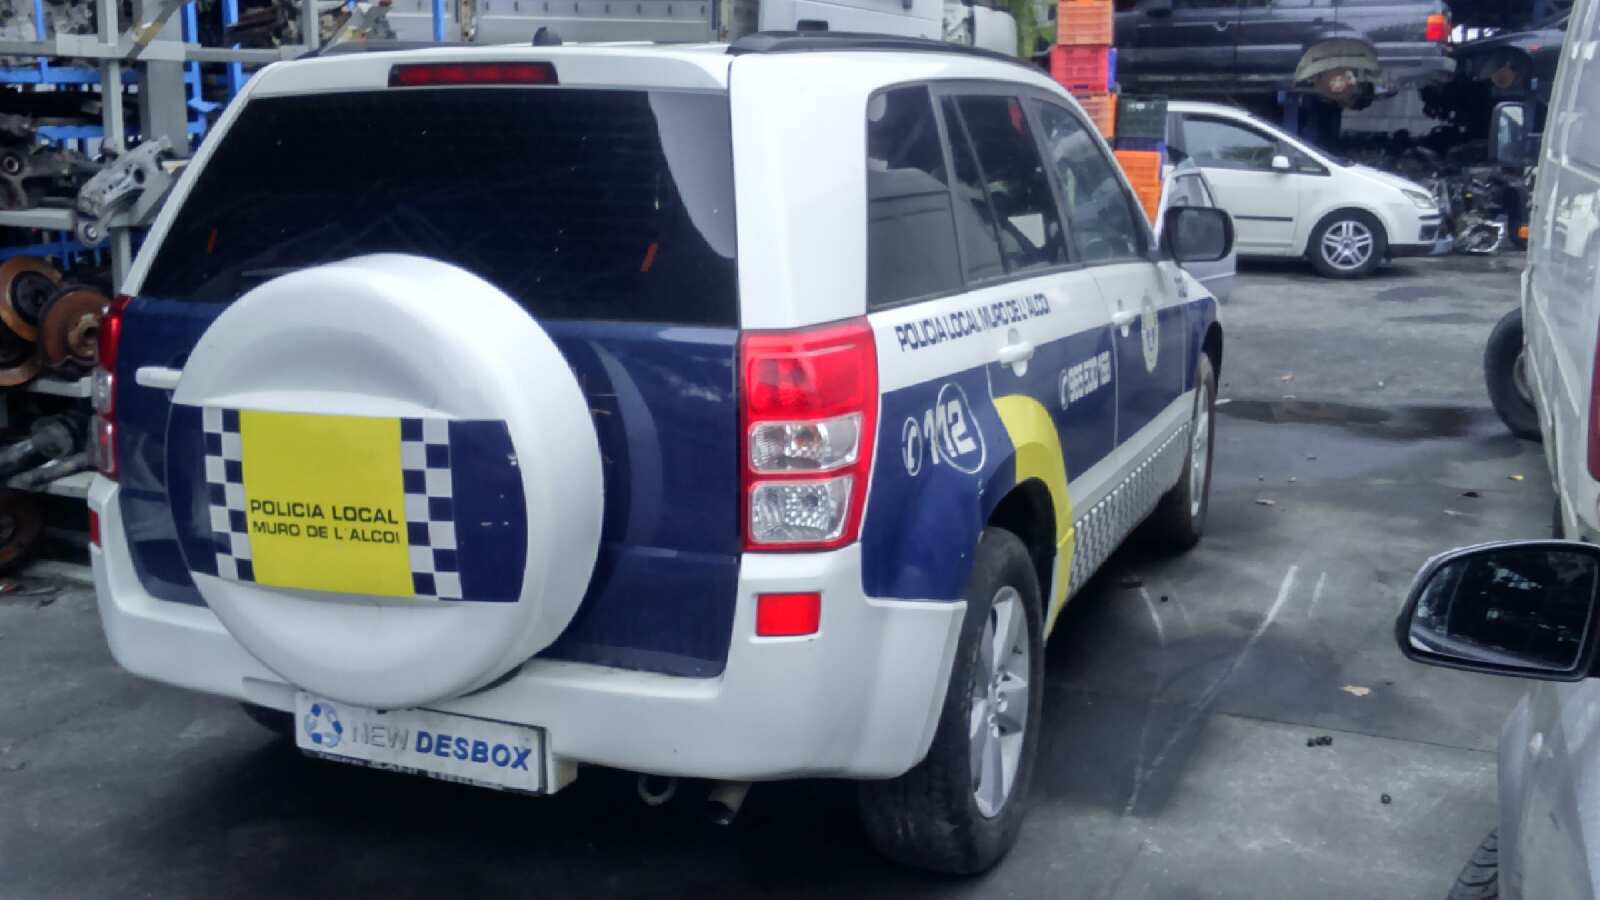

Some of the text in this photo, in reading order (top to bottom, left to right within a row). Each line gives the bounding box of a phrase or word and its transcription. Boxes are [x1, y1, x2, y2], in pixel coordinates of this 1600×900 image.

[895, 318, 949, 352] POLICIA
[945, 309, 982, 340] LOCAL
[924, 400, 977, 465] 112
[250, 499, 399, 525] POLICIA LOCAL
[252, 521, 301, 537] MURO
[307, 525, 329, 540] DE
[351, 719, 410, 751] NEW
[414, 730, 533, 771] DESBOX
